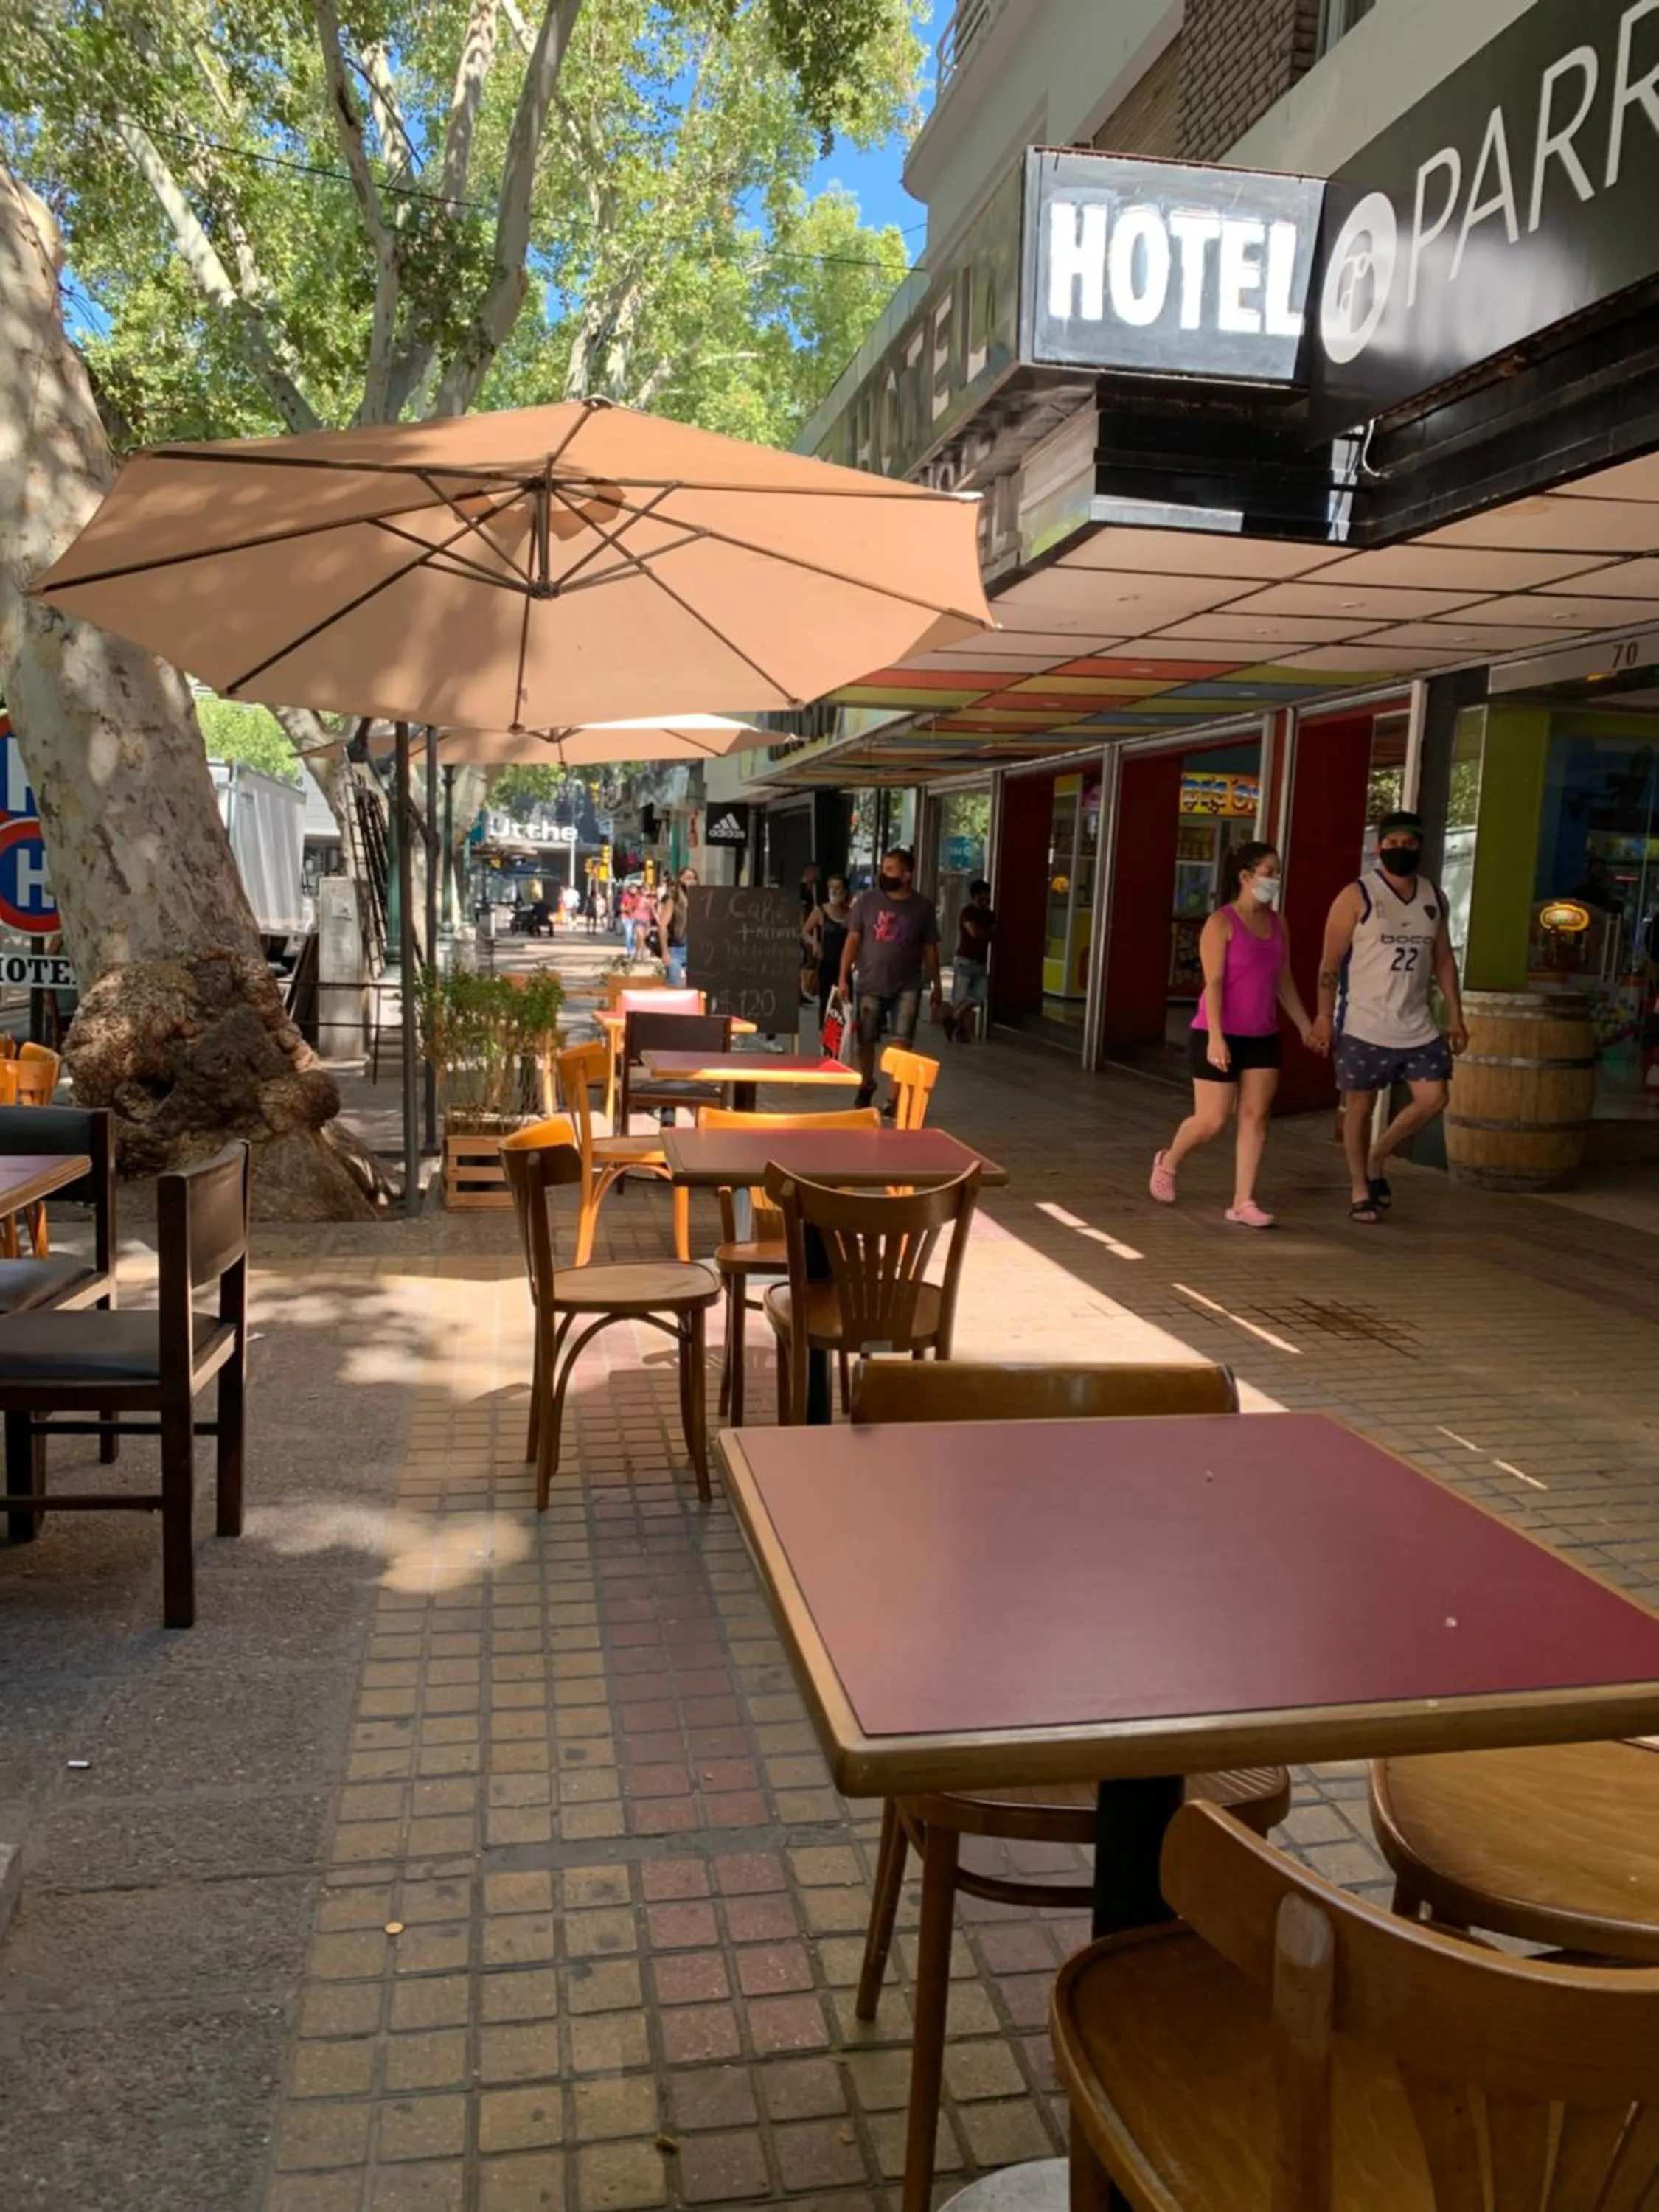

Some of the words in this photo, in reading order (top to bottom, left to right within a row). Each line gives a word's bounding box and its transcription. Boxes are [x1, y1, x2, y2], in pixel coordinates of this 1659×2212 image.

[1048, 202, 1306, 336] HOTEL
[1613, 641, 1638, 668] 70
[0, 957, 77, 984] OTE
[1390, 947, 1418, 971] 22
